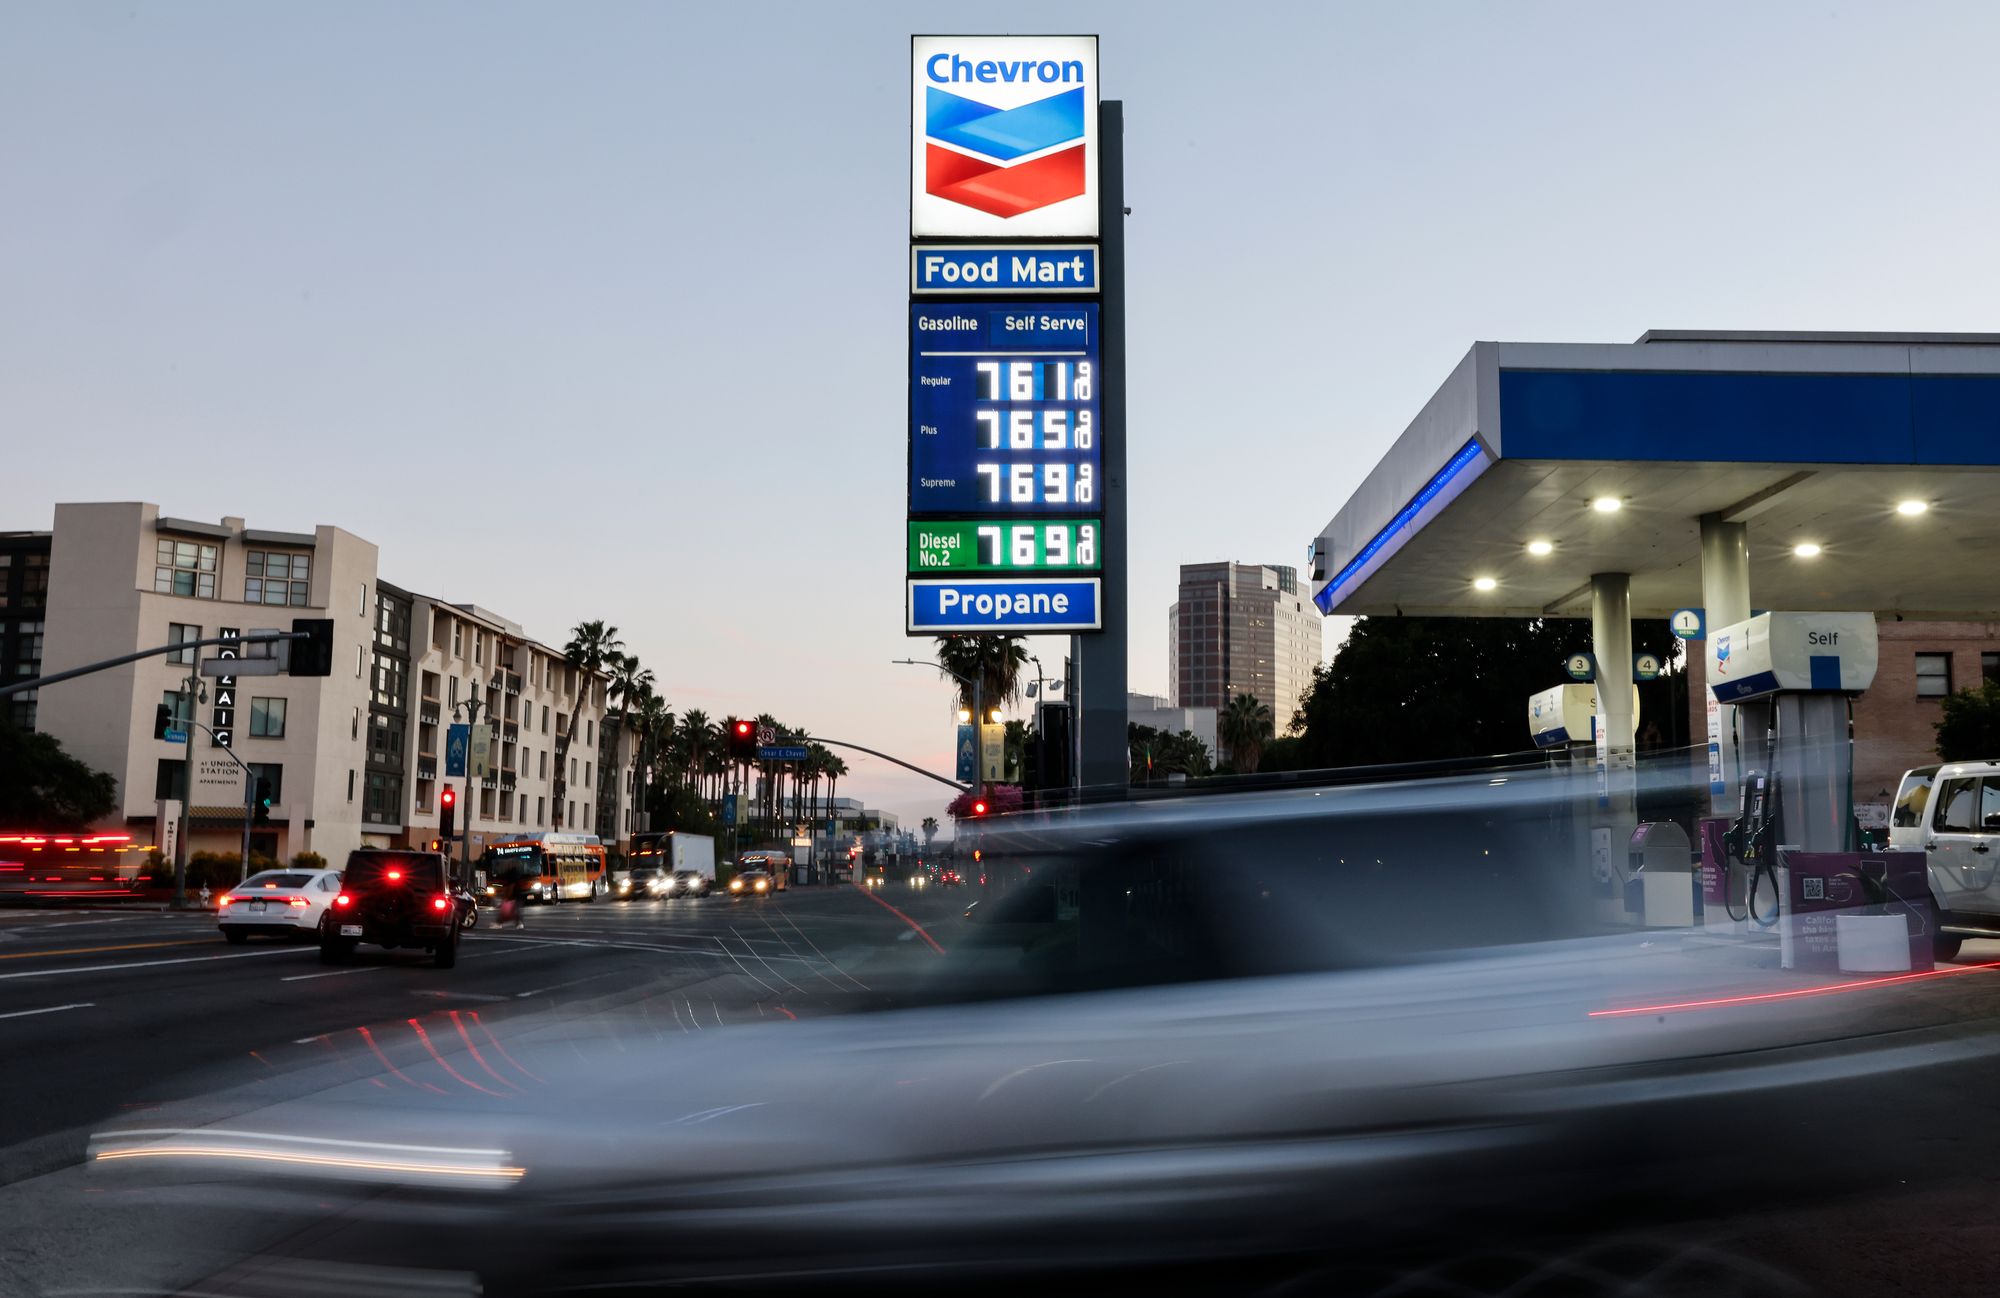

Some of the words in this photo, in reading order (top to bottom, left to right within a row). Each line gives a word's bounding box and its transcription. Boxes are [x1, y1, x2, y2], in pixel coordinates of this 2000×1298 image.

[926, 53, 1084, 83] Chevron
[925, 256, 998, 282] Food
[1011, 255, 1085, 282] Mart
[918, 316, 978, 331] Gasoline
[1005, 315, 1036, 331] Self
[1040, 316, 1085, 331] Serve
[920, 376, 951, 387] Regular
[920, 425, 937, 435] Plus
[920, 478, 956, 489] Supreme
[919, 533, 960, 549] Diesel
[919, 550, 950, 566] No.2
[939, 589, 1069, 620] Propane
[1683, 616, 1688, 627] 1
[1808, 631, 1838, 645] Self
[1576, 659, 1584, 670] 3
[1643, 659, 1652, 670] 4
[210, 760, 239, 768] UNION
[200, 767, 239, 775] STATION
